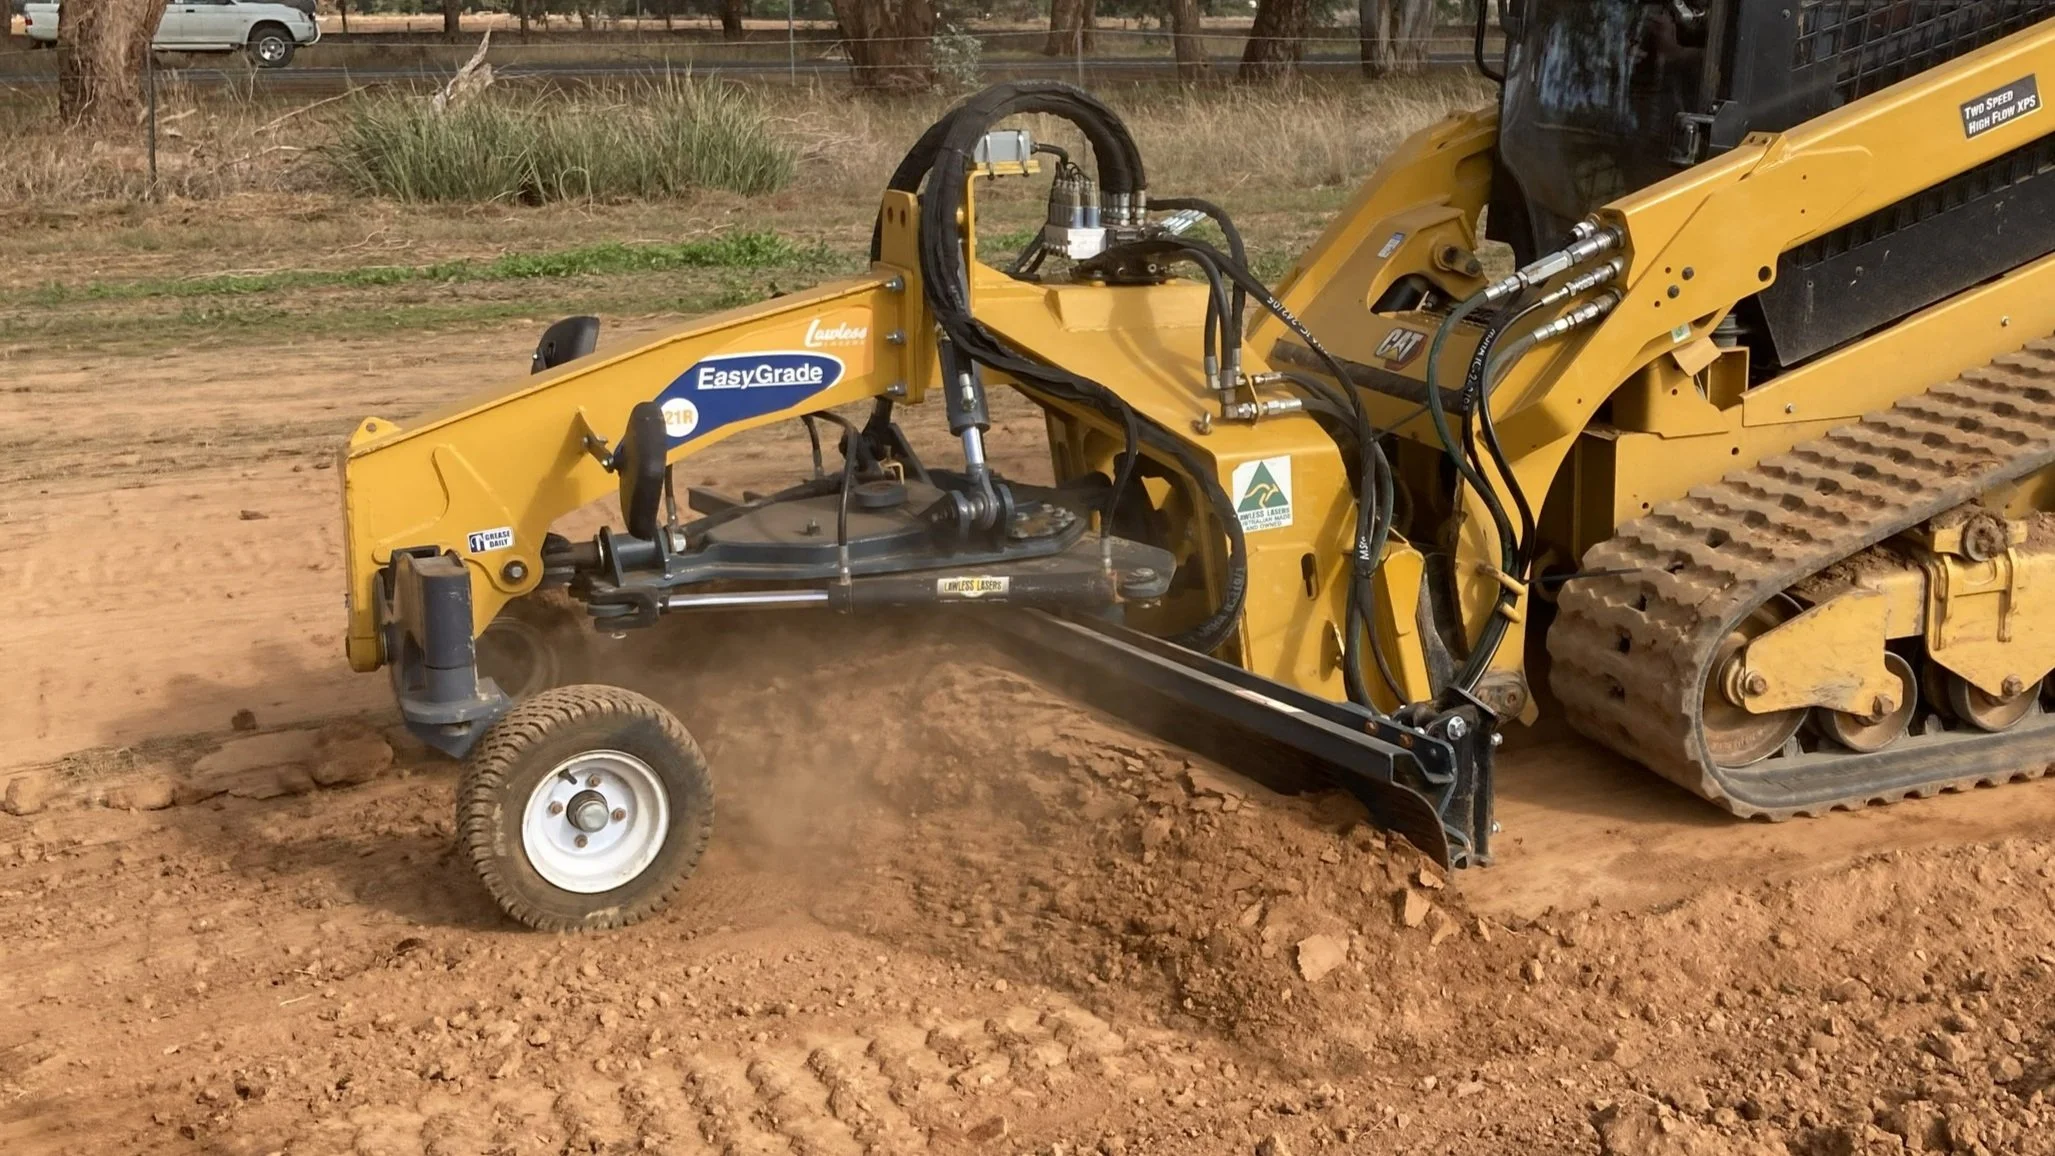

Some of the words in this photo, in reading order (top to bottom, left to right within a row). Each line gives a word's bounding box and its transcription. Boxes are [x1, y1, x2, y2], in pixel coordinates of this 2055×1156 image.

[1986, 90, 2014, 111] SPEED
[1968, 117, 1991, 135] HIGH
[1992, 105, 2015, 125] FLOW
[2017, 95, 2036, 113] XPS
[804, 318, 868, 348] Lawless
[1376, 328, 1425, 362] CAT
[697, 362, 823, 390] EasyGrade
[664, 407, 694, 426] 21R
[485, 530, 511, 541] GREASE
[489, 538, 509, 548] DAILY
[944, 579, 975, 592] LAWLESS
[976, 579, 1002, 592] LASERS
